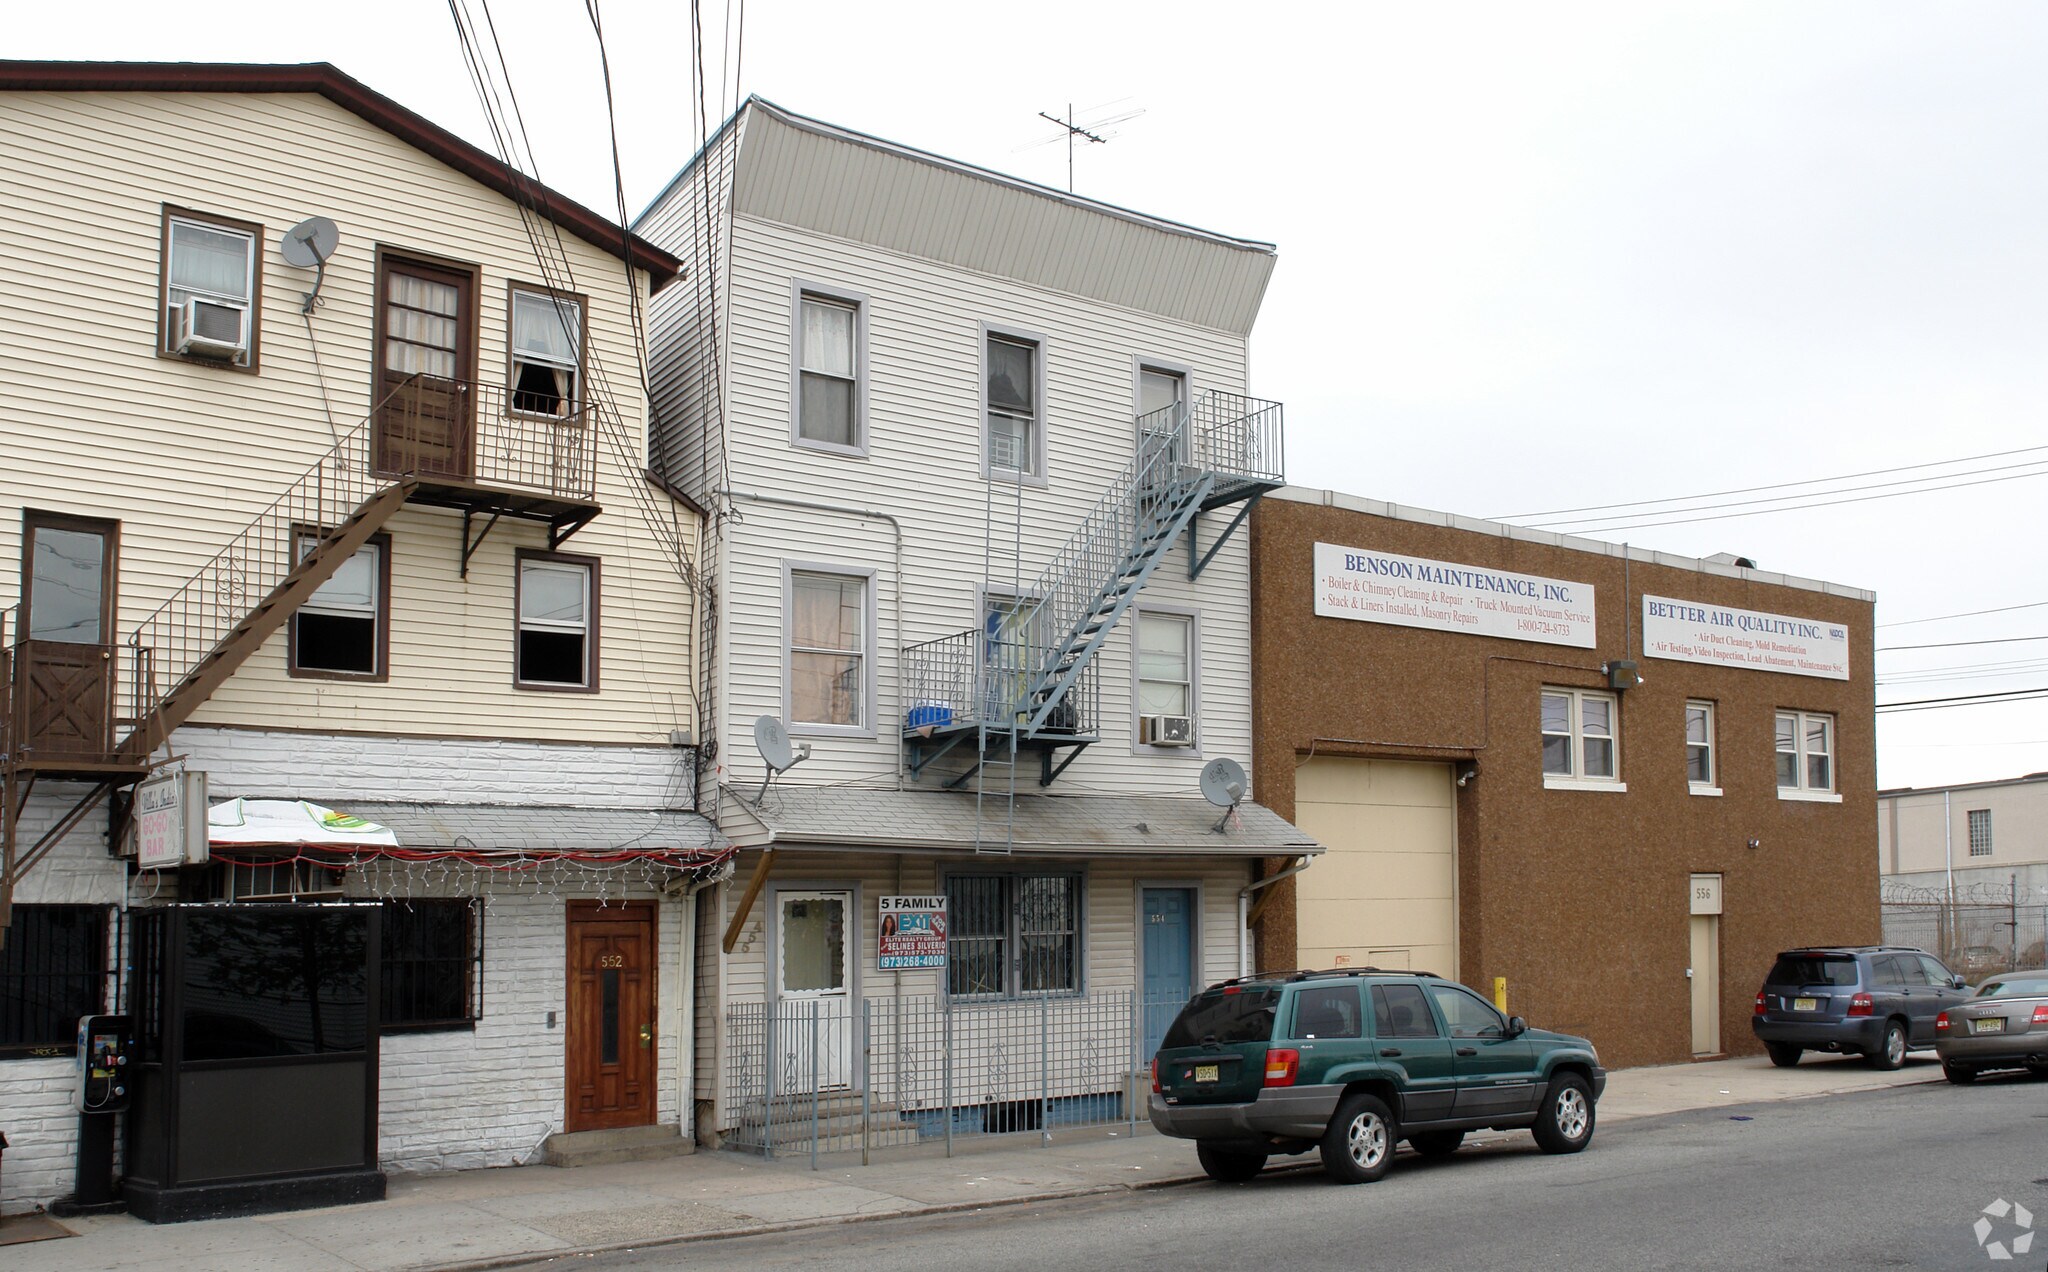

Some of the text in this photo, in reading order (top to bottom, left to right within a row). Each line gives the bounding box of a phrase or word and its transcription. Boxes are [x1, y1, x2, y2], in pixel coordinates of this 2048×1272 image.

[1344, 553, 1573, 603] BENSON MAINTENANCE, INC.
[1328, 576, 1463, 608] Boiler & Chimney Cleaning & Repair
[1328, 594, 1479, 625] Stack & Liners Installed, Masonry Repairs
[1475, 597, 1590, 624] Truck Mounted Vacuum Service
[1649, 601, 1823, 640] BETTER AIR QUALITY INC.
[1698, 632, 1807, 655] Air Duct Cleaning, Mold Remediation
[1655, 641, 1667, 652] Air
[1694, 645, 1711, 657] Video
[1713, 648, 1745, 663] Inspection,
[1747, 652, 1762, 664] Lead
[1797, 659, 1832, 672] Maintenance
[146, 837, 164, 857] BAR
[881, 898, 945, 909] 5 FAMILY
[1696, 888, 1711, 899] 556
[917, 941, 946, 950] SILVERIO
[601, 955, 623, 968] 552
